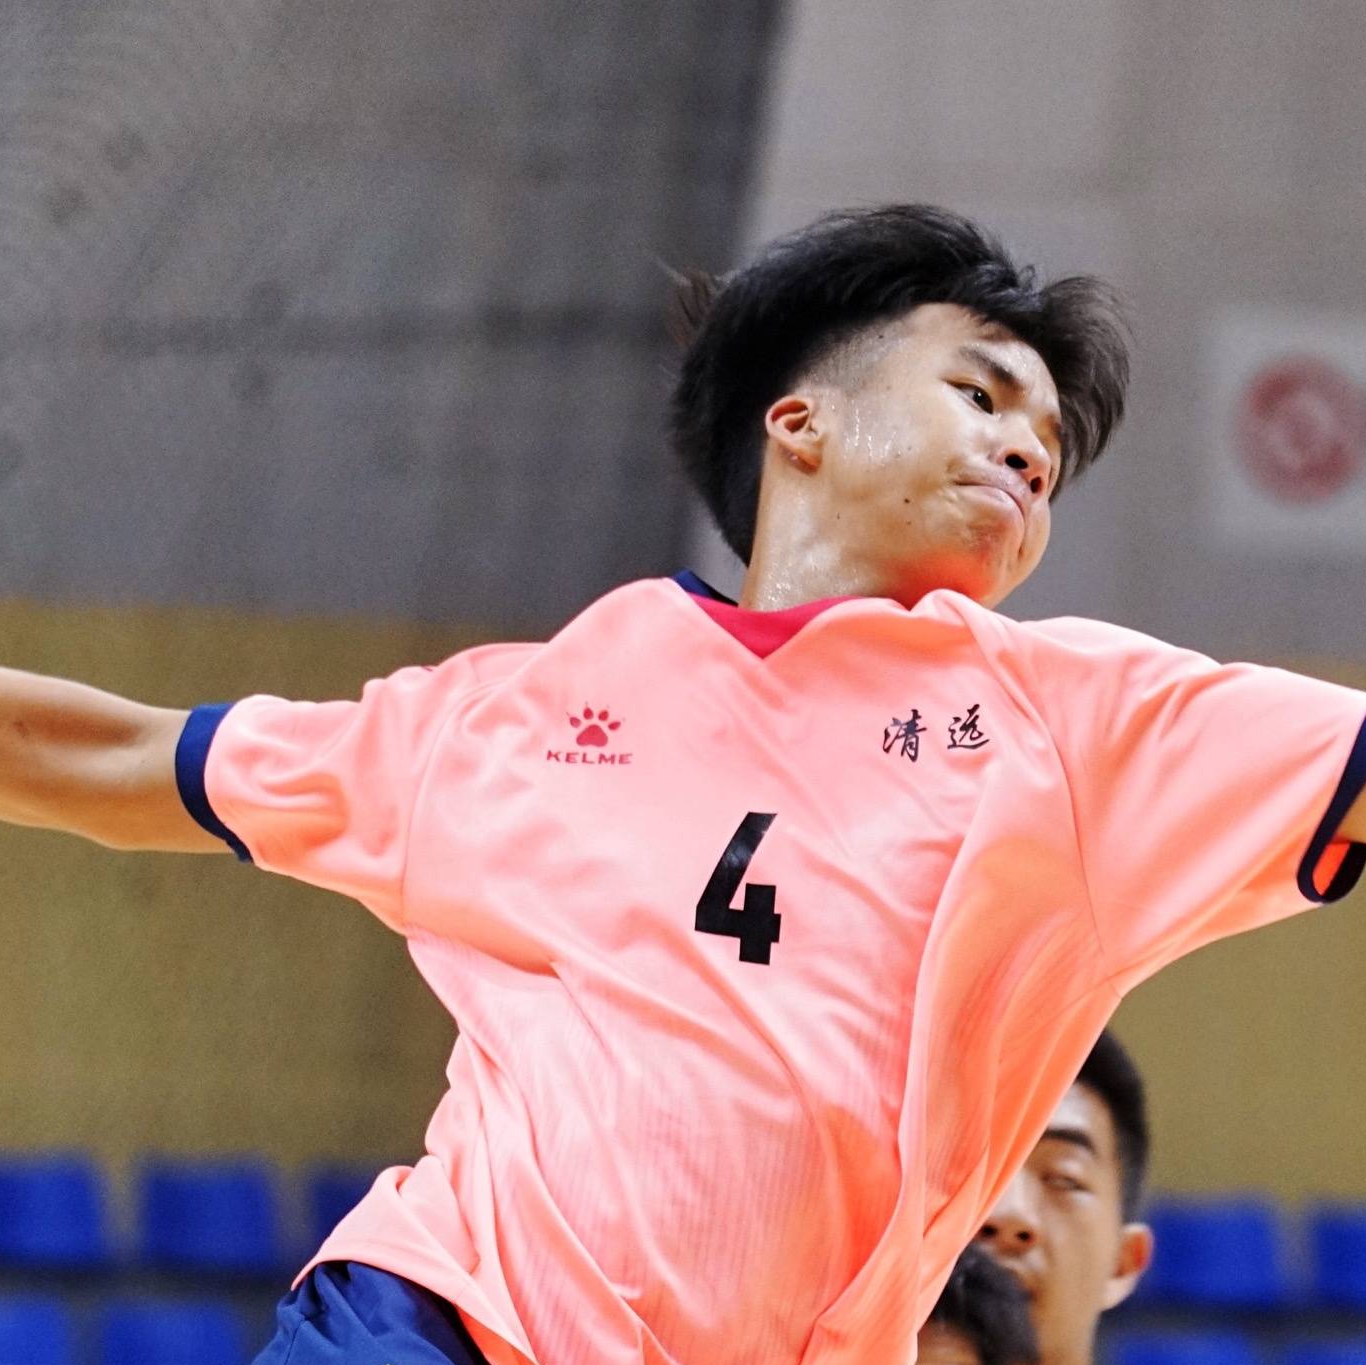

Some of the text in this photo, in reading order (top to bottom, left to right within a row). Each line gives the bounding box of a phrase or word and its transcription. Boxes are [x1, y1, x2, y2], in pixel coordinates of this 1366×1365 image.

[546, 749, 633, 765] KELME
[882, 703, 990, 763] 清远
[694, 811, 782, 966] 4
